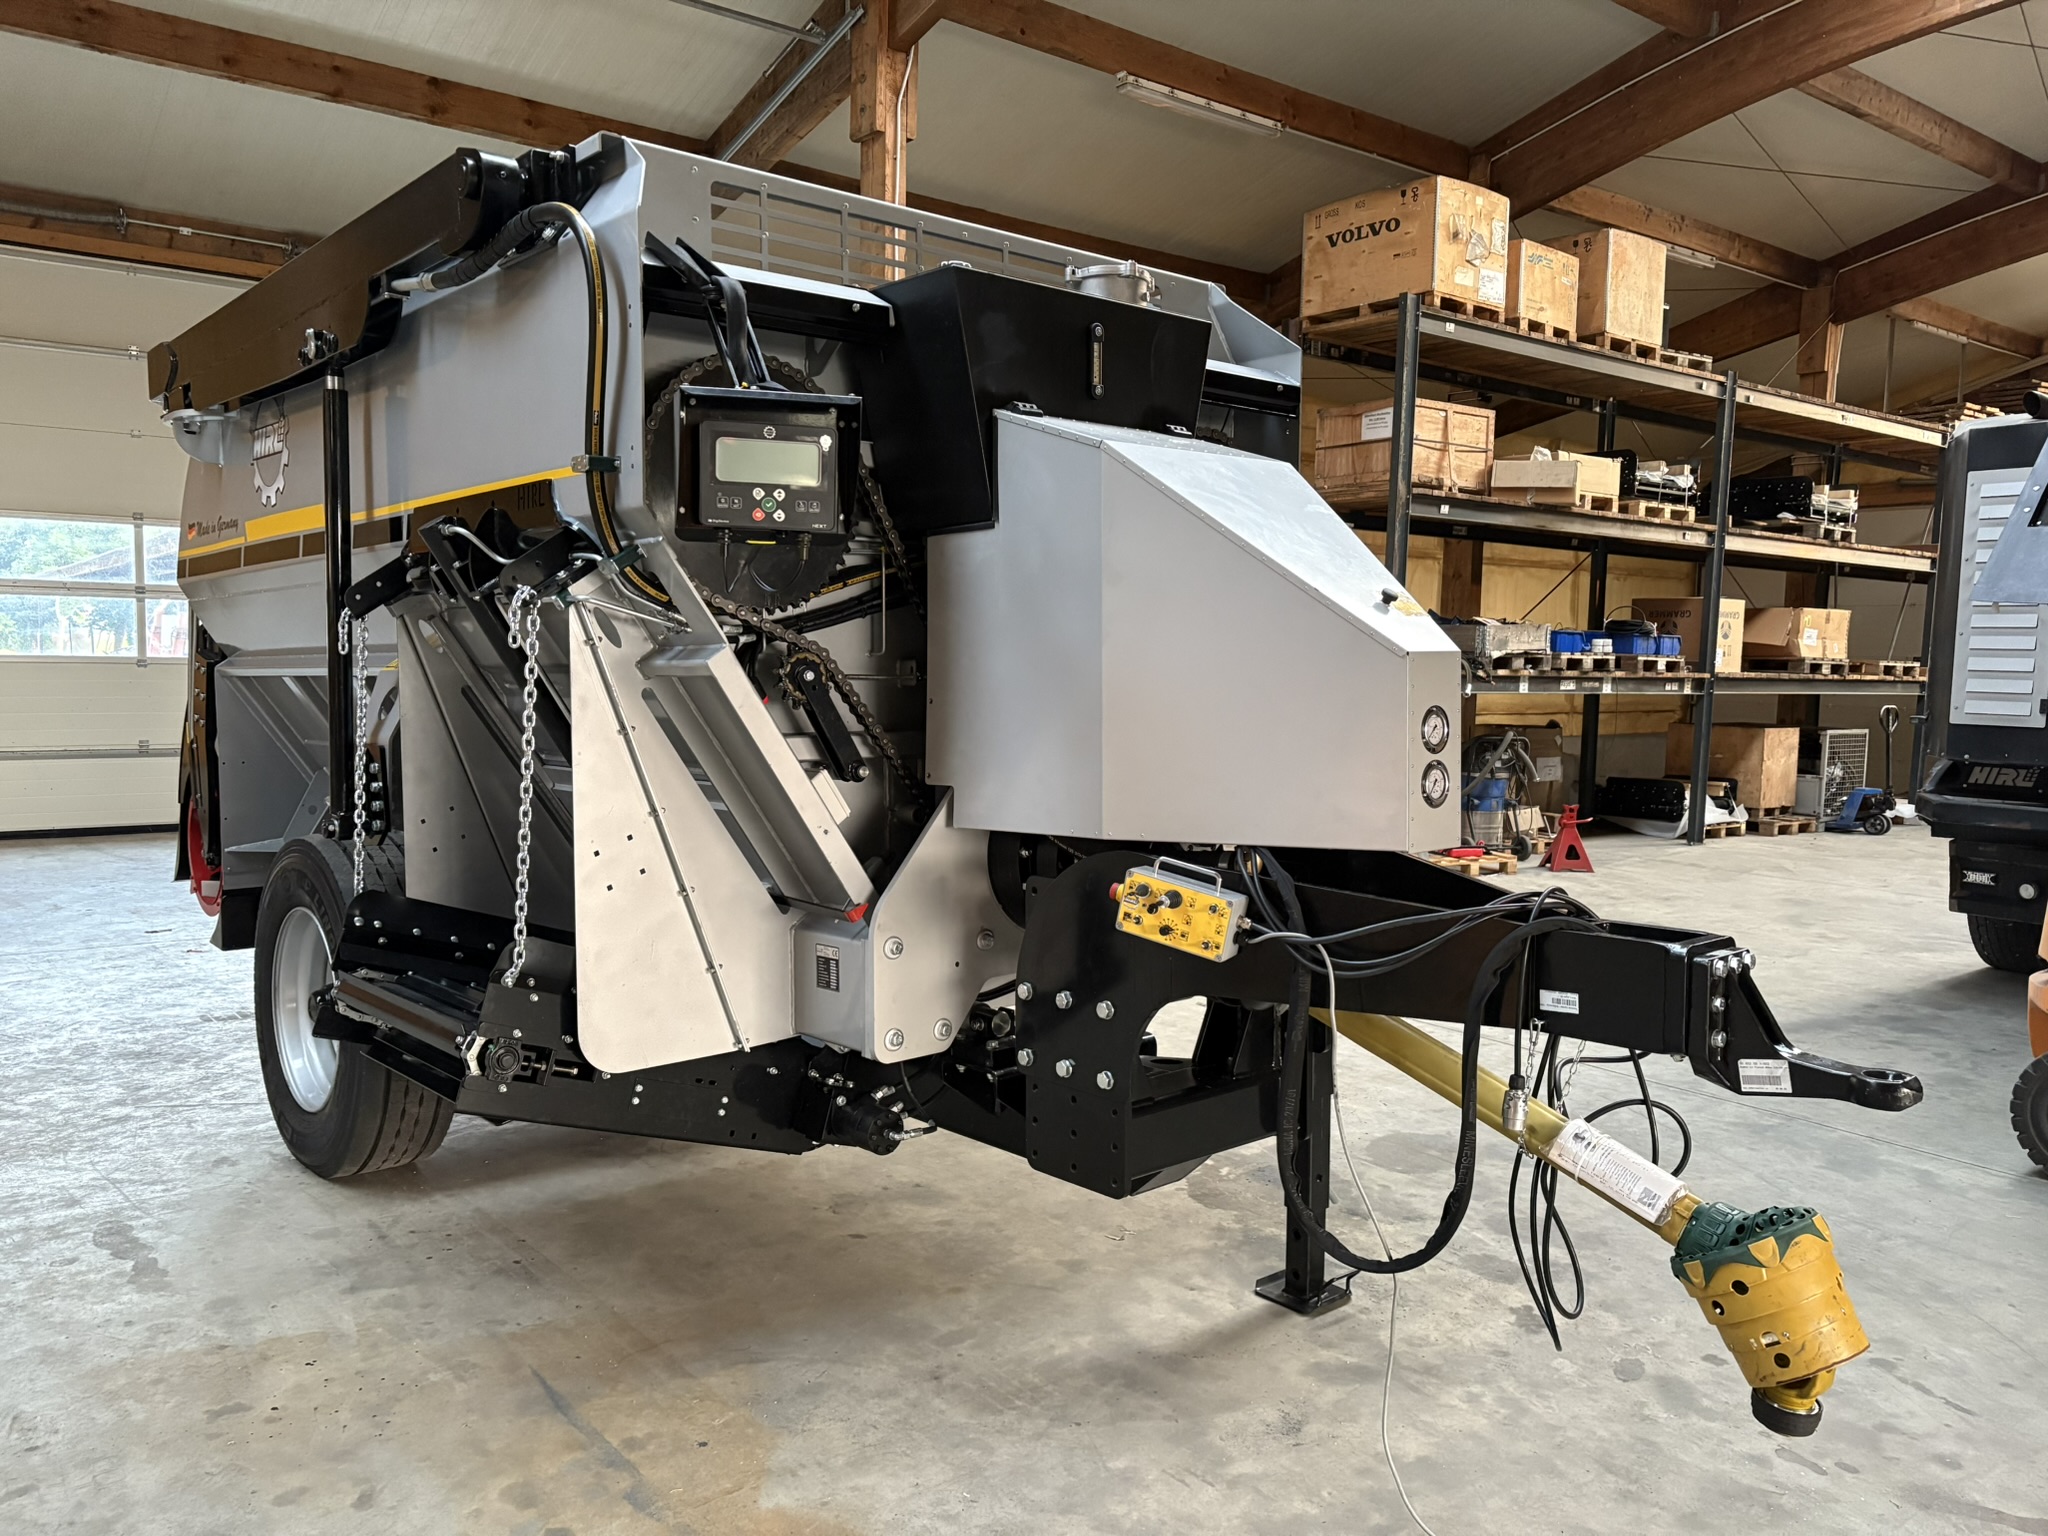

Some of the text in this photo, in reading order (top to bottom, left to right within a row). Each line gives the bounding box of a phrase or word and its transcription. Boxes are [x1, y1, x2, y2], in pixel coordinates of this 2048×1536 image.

[1325, 217, 1401, 248] VOLVO
[253, 417, 284, 461] HIRL
[517, 482, 545, 511] HIRL
[196, 520, 211, 537] Made
[217, 515, 239, 539] Germany
[1648, 609, 1692, 619] GRAMMER
[1967, 766, 2041, 788] HIRL
[831, 949, 839, 958] CE
